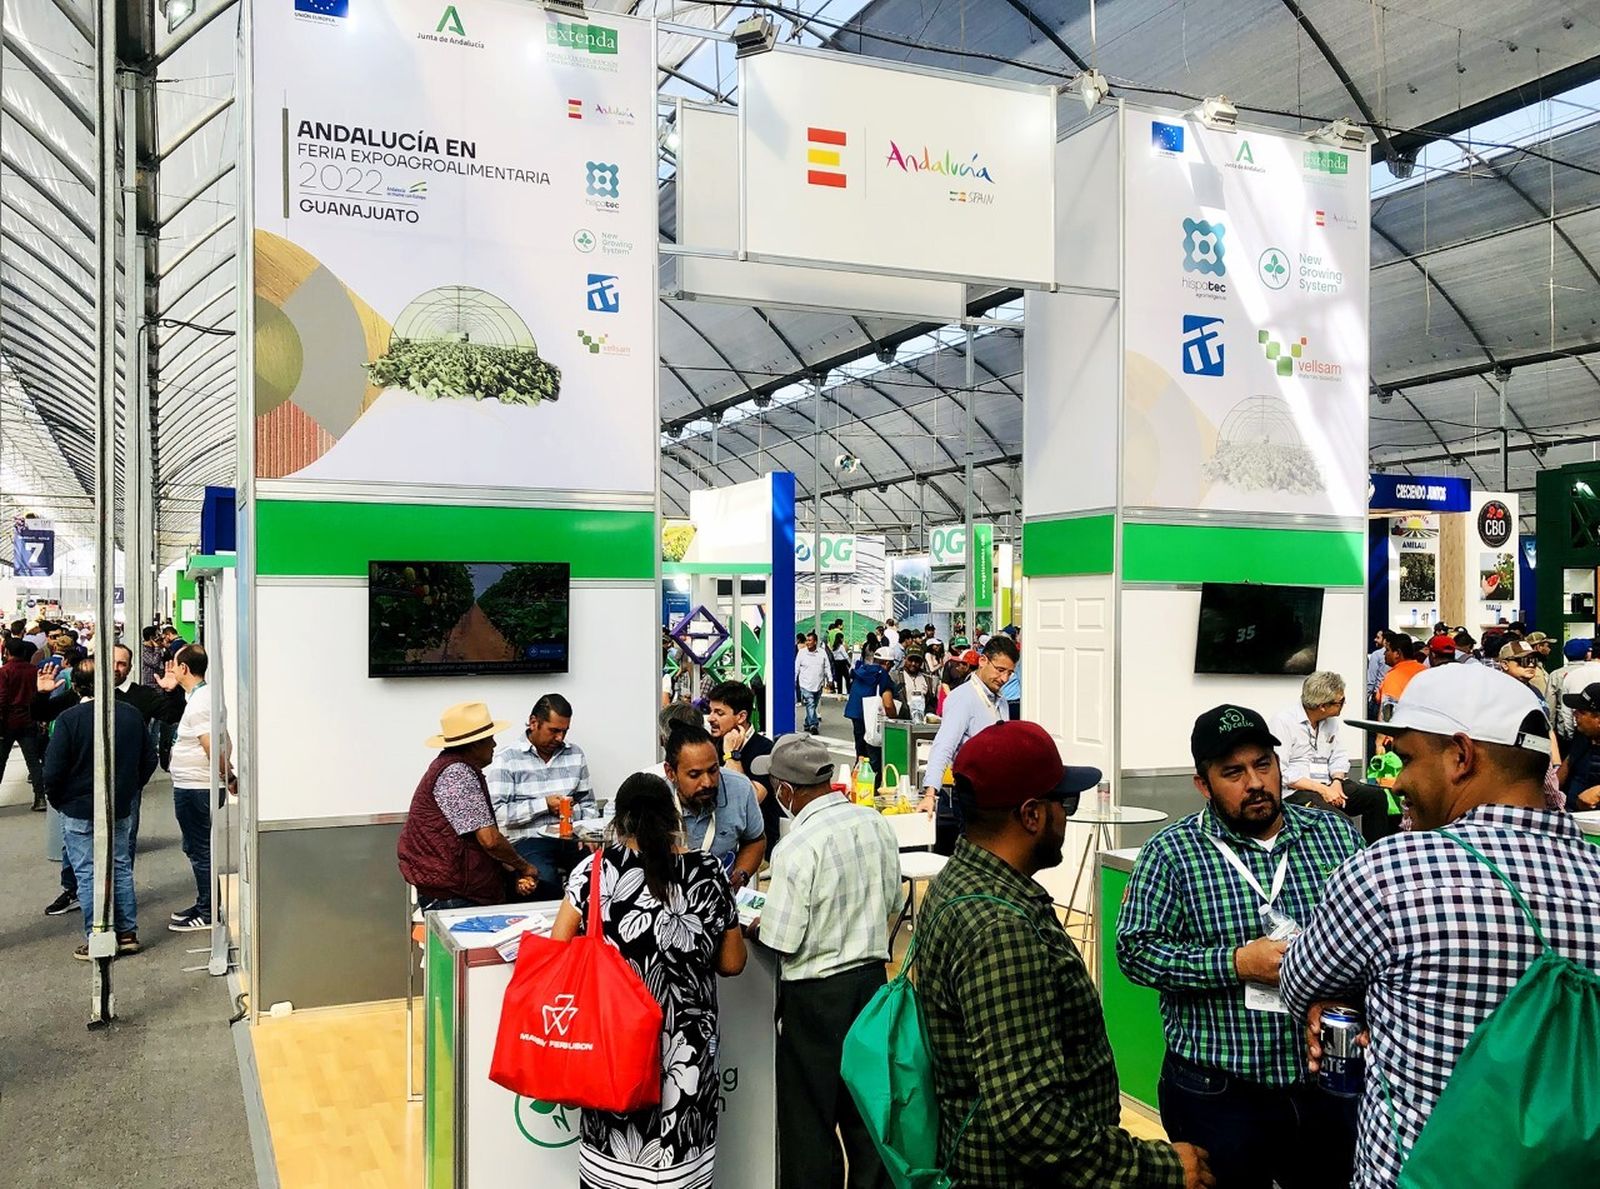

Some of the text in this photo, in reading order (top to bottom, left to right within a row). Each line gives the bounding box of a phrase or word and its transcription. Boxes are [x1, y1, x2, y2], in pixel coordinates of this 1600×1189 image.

[417, 32, 438, 42] Junta
[548, 27, 615, 49] extenda
[297, 120, 476, 159] ANDALUCÍA EN
[298, 142, 551, 185] FERIA EXPOAGROALIMENTARIA
[886, 139, 995, 184] Andalucía
[299, 161, 383, 195] 2022
[968, 192, 994, 205] SPAIN
[299, 199, 419, 223] GUANAJUATO
[1299, 252, 1322, 265] New
[1182, 275, 1226, 293] hispatec
[1300, 265, 1342, 285] Growing
[1300, 278, 1338, 292] System
[1298, 360, 1342, 374] vellsam
[1396, 483, 1426, 500] CRECIENDO
[1485, 519, 1505, 536] CBO
[25, 542, 44, 563] 7
[813, 537, 853, 568] QG
[932, 529, 965, 562] QG
[549, 1039, 593, 1051] FERGUSON
